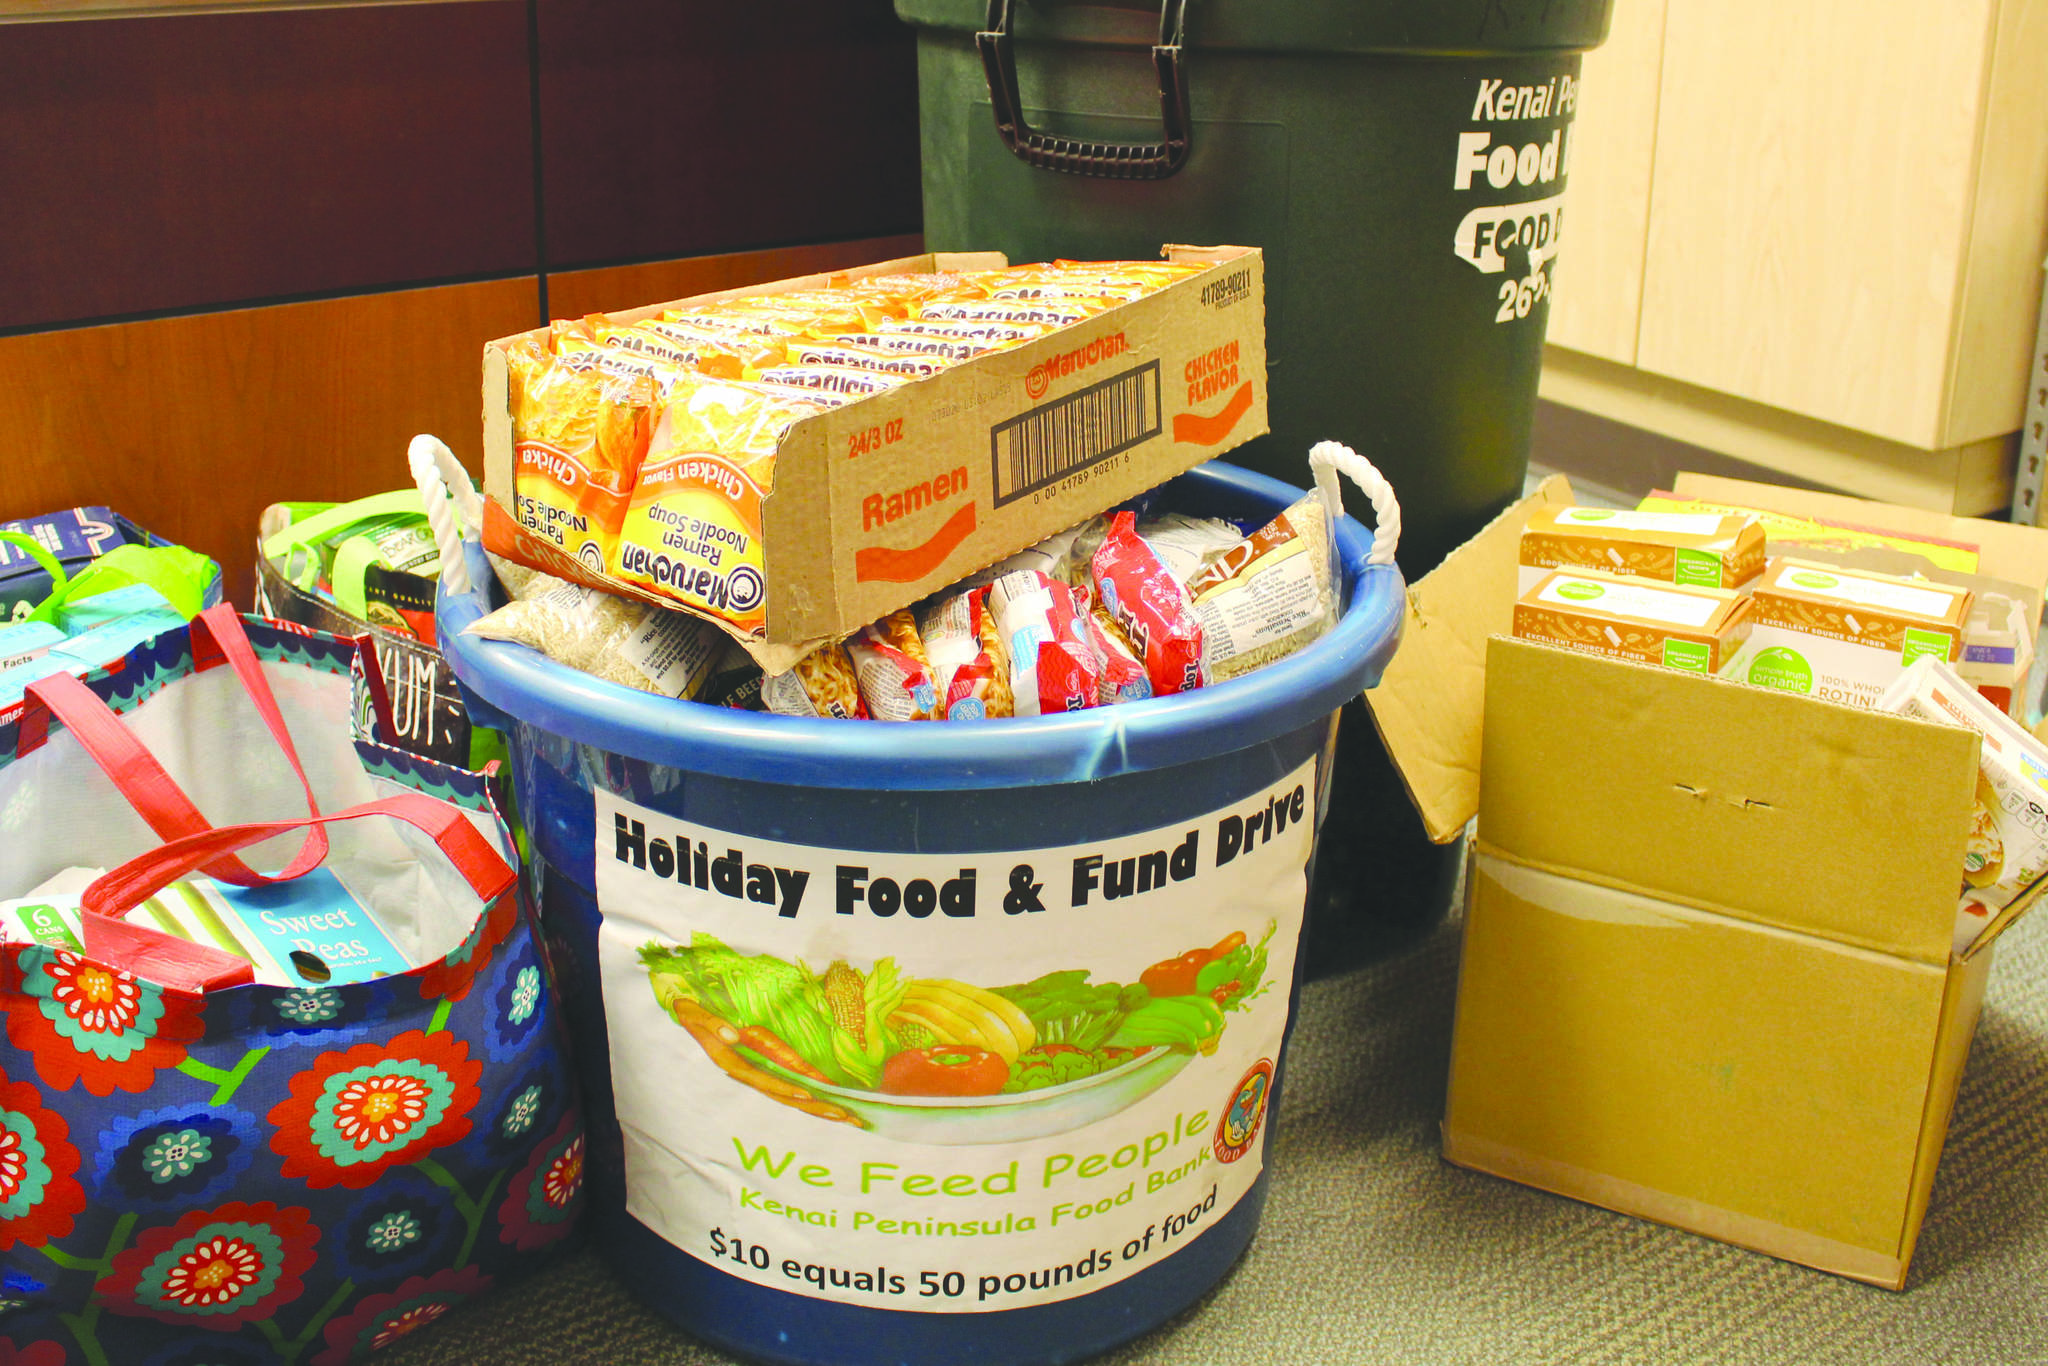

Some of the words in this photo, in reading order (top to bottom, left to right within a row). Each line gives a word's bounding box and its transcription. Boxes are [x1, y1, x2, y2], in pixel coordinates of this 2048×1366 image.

[1472, 77, 1556, 121] Kenai
[1454, 129, 1561, 190] Food
[1473, 213, 1551, 258] FOOD
[1201, 268, 1250, 307] 41789-90211
[1045, 332, 1125, 381] Maruchan
[1184, 339, 1239, 383] CHICKEN
[1188, 363, 1238, 406] FLAVOR
[848, 426, 882, 459] 24/3
[885, 417, 903, 442] OZ
[522, 449, 576, 486] Chicke
[643, 463, 676, 486] Flavor
[678, 461, 744, 499] Chicken
[1061, 471, 1089, 492] 41789
[1093, 458, 1119, 479] 90211
[1123, 453, 1129, 464] 6
[517, 494, 535, 515] So
[862, 465, 968, 532] Ramen
[538, 505, 588, 533] Noodle
[648, 505, 686, 532] Soup
[662, 533, 722, 566] Ramen
[689, 520, 748, 553] Noodle
[621, 543, 729, 610] Maruchan
[1612, 567, 1636, 576] FIBER
[393, 593, 432, 607] QUALIT
[1526, 632, 1570, 648] EXCELLENT
[1573, 641, 1604, 653] SOURCE
[1607, 648, 1618, 656] OF
[1621, 651, 1646, 660] FIBER
[1762, 618, 1809, 633] EXCELLENT
[1811, 627, 1844, 641] SOURCE
[1847, 634, 1858, 642] OF
[1861, 638, 1886, 648] FIBER
[3, 655, 33, 669] Facts
[1755, 664, 1784, 677] simple
[1785, 669, 1808, 682] truth
[1754, 673, 1808, 693] organic
[1821, 674, 1849, 688] 100%
[614, 812, 811, 919] Holiday
[835, 865, 976, 919] Food
[1003, 864, 1046, 915] &
[1071, 829, 1200, 908] Fund
[1215, 784, 1305, 868] Drive
[32, 908, 52, 927] 6
[35, 926, 64, 935] CANS
[259, 906, 356, 937] Sweet
[732, 1136, 834, 1187] We
[860, 1160, 1018, 1197] Feed
[1042, 1109, 1210, 1189] People
[740, 1186, 837, 1228] Kenai
[853, 1211, 1036, 1237] Peninsula
[1051, 1182, 1135, 1227] Food
[1146, 1146, 1211, 1195] Bank
[709, 1226, 770, 1270] $10
[781, 1258, 906, 1295] equals
[918, 1271, 965, 1298] 50
[978, 1249, 1113, 1301] pounds
[1122, 1225, 1155, 1261] of
[1161, 1183, 1218, 1244] food
